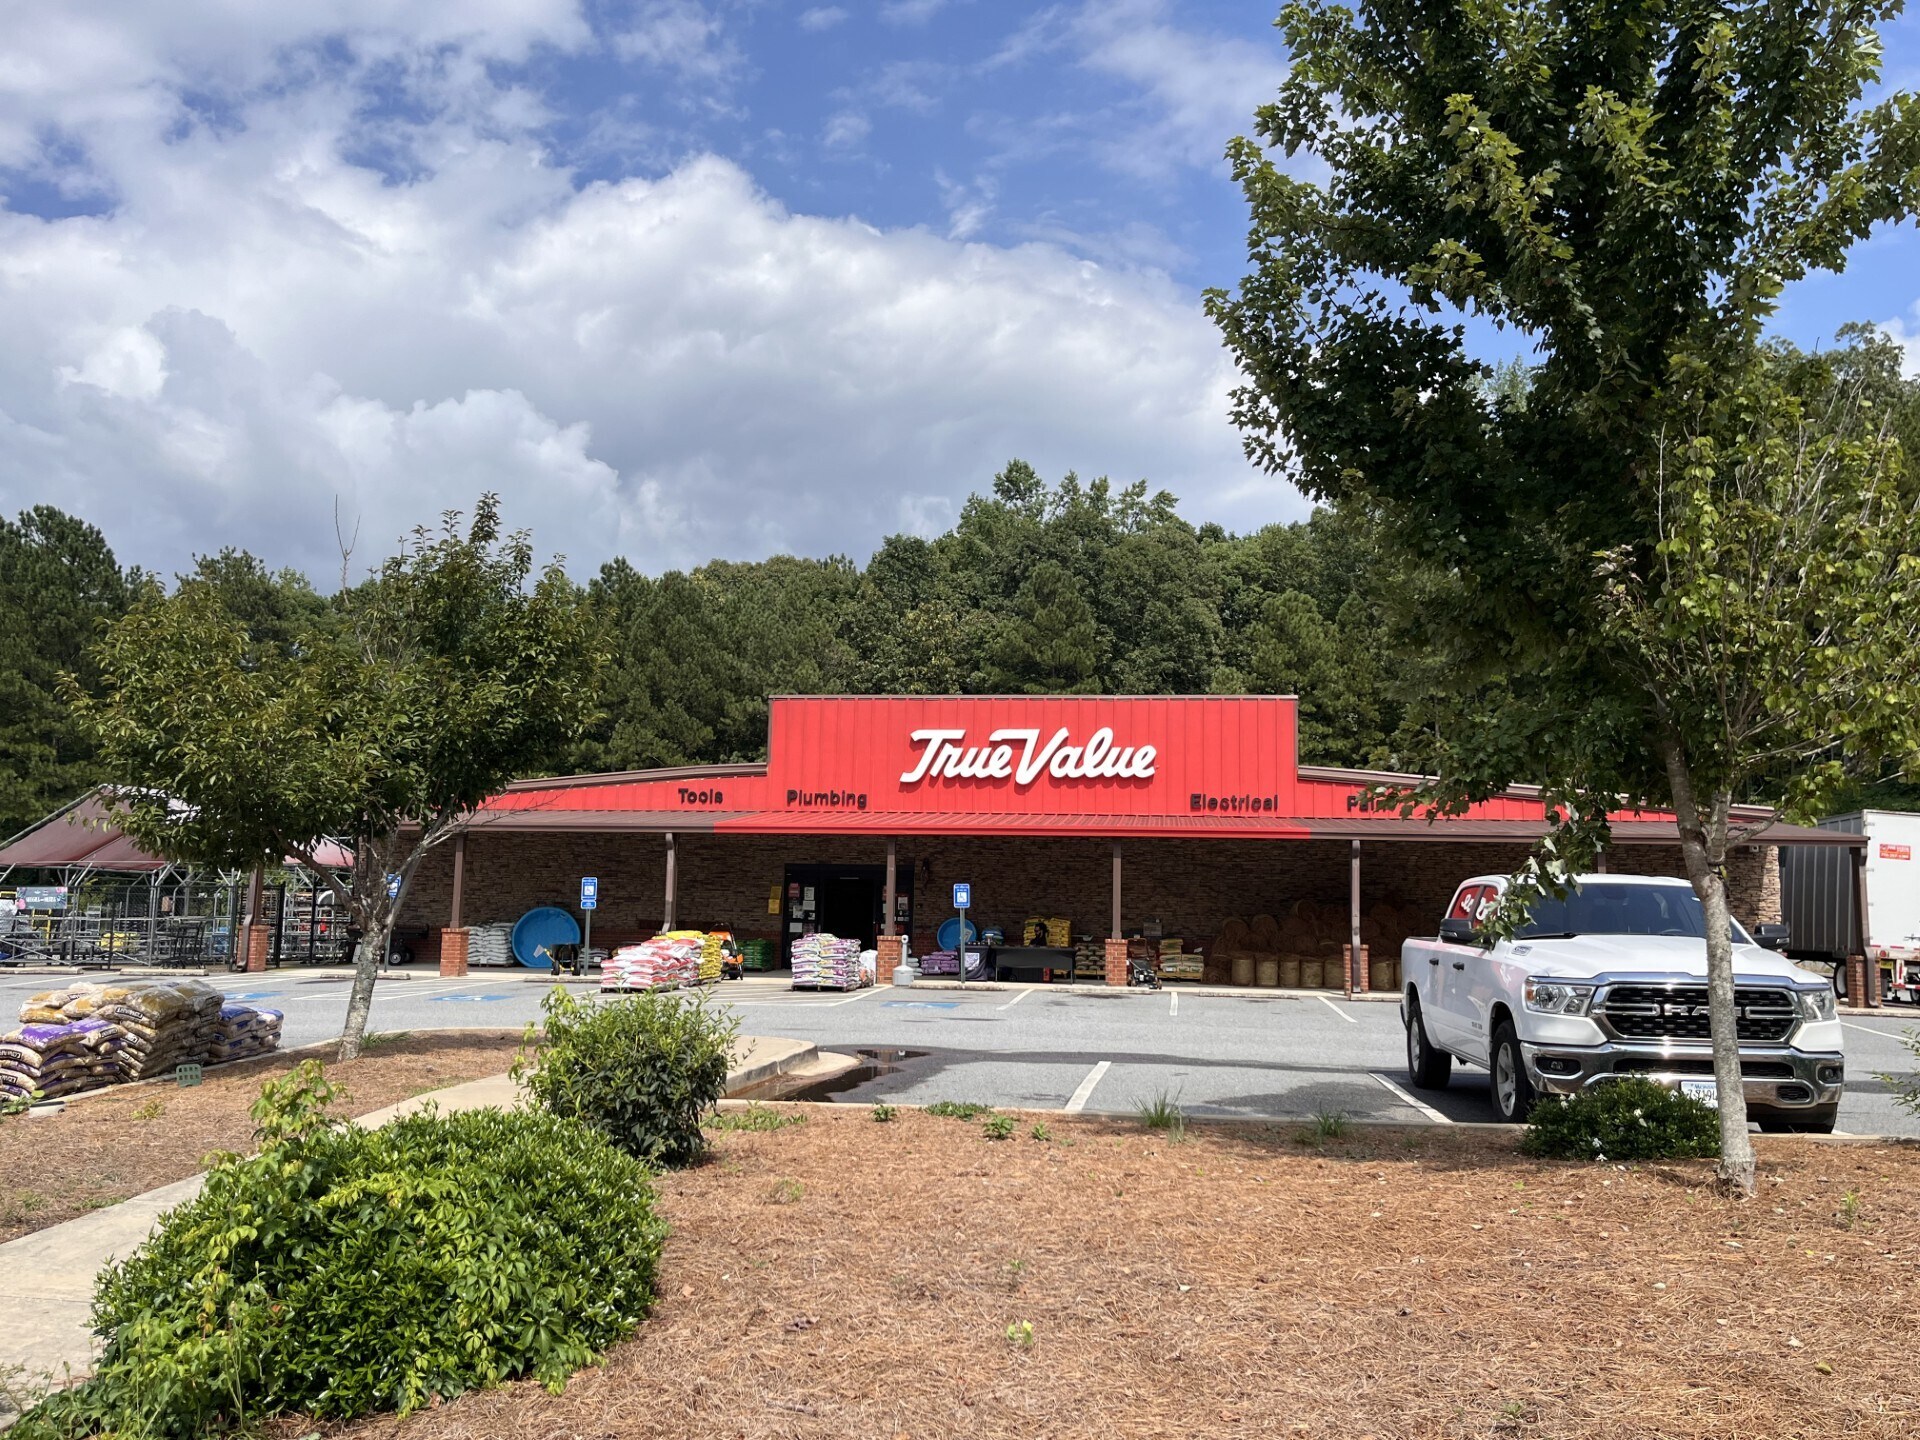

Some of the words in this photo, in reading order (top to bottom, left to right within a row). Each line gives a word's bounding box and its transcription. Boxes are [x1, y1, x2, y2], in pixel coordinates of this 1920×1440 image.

[899, 728, 1013, 783] True
[989, 727, 1158, 785] Value
[678, 788, 724, 805] Tools
[786, 789, 867, 810] Plumbing
[1190, 793, 1278, 812] Electrical
